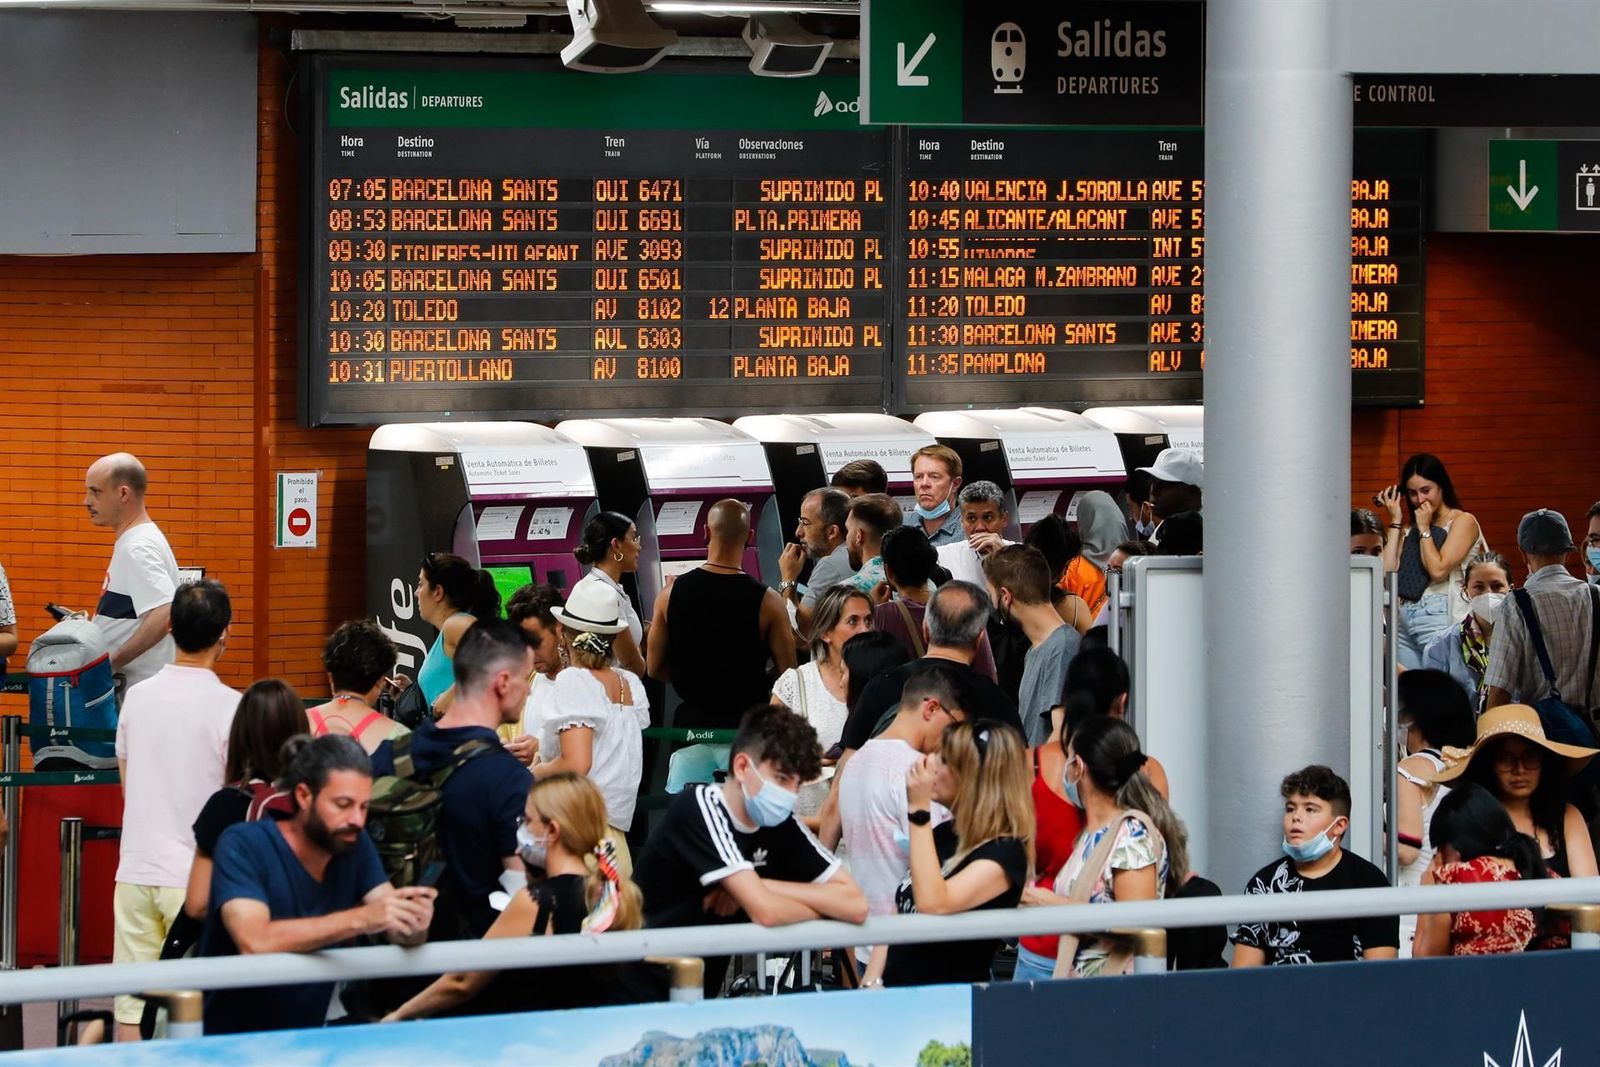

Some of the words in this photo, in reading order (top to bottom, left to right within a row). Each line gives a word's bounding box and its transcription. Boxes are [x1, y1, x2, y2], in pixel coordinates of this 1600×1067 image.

[1057, 19, 1166, 58] Salidas
[1057, 77, 1159, 95] DEPARTURES
[1369, 85, 1435, 102] CONTROL
[340, 86, 408, 109] Salidas
[422, 96, 483, 108] DEPARTURES
[341, 136, 364, 147] Hora
[398, 136, 434, 148] Destino
[605, 136, 625, 147] Tren
[695, 137, 710, 149] Vía
[739, 138, 803, 150] Observaciones
[919, 140, 940, 151] Hora
[971, 140, 1004, 151] Destino
[1158, 141, 1177, 151] Tren
[330, 179, 386, 201] 07:05
[392, 179, 492, 201] BARCELONA
[503, 179, 558, 201] SANTS
[639, 179, 682, 201] 6471
[761, 179, 855, 201] SUPRIMIDO
[865, 179, 883, 201] PL
[909, 180, 960, 201] 10:40
[965, 180, 1047, 201] VALENCIA
[1057, 180, 1147, 201] J.SOROLLA
[1152, 180, 1182, 201] AVE
[1192, 180, 1204, 201] 5
[330, 209, 386, 231] 08:53
[392, 209, 492, 231] BARCELONA
[503, 209, 557, 231] SANTS
[639, 209, 682, 231] 6691
[735, 209, 861, 231] PLTA.PRIMERA
[909, 208, 960, 230] 10:45
[964, 208, 1127, 230] ALICANTE/ALACANT
[1152, 208, 1182, 230] AVE
[1192, 208, 1204, 230] 5
[329, 240, 386, 261] 09:30
[595, 240, 628, 261] AVE
[639, 240, 682, 261] 3093
[760, 239, 855, 260] SUPRIMIDO
[865, 239, 883, 260] PL
[909, 238, 960, 259] 10:55
[1152, 237, 1182, 258] INT
[330, 269, 386, 291] 10:05
[391, 269, 492, 291] BARCELONA
[503, 269, 557, 291] SANTS
[638, 269, 682, 291] 6501
[760, 268, 854, 290] SUPRIMIDO
[865, 268, 883, 290] PL
[908, 267, 960, 289] 11:15
[964, 266, 1026, 288] MALAGA
[1036, 266, 1137, 288] M.ZAMBRANO
[1151, 266, 1182, 288] AVE
[1191, 266, 1204, 288] 2
[330, 300, 386, 322] 10:20
[393, 300, 458, 322] TOLEDO
[595, 300, 617, 322] AV
[638, 298, 682, 320] 8102
[709, 298, 730, 320] 12
[734, 297, 797, 319] PLANTA
[808, 297, 850, 319] BAJA
[908, 296, 960, 317] 11:20
[965, 295, 1026, 317] TOLEDO
[1151, 294, 1172, 316] AV
[330, 330, 386, 352] 10:30
[391, 328, 491, 351] BARCELONA
[502, 328, 557, 350] SANTS
[594, 328, 628, 350] AVL
[638, 328, 681, 350] 6303
[759, 326, 854, 348] SUPRIMIDO
[864, 326, 882, 348] PL
[908, 325, 960, 346] 11:30
[964, 324, 1056, 345] BARCELONA
[1065, 323, 1117, 344] SANTS
[1151, 323, 1182, 344] AVE
[1191, 323, 1204, 344] 3
[330, 360, 386, 383] 10:31
[390, 358, 513, 381] PUERTOLLANO
[594, 357, 617, 380] AV
[637, 357, 681, 380] 8100
[733, 355, 797, 378] PLANTA
[808, 355, 850, 378] BAJA
[908, 354, 960, 376] 11:35
[963, 353, 1046, 375] PAMPLONA
[1150, 352, 1182, 374] ALV
[825, 450, 843, 458] Venta
[887, 448, 911, 456] Billetes
[1061, 445, 1068, 453] de
[1068, 444, 1092, 453] Billetes
[465, 460, 485, 469] Venta
[523, 459, 533, 467] de
[533, 458, 558, 466] Billetes
[695, 731, 714, 740] adif
